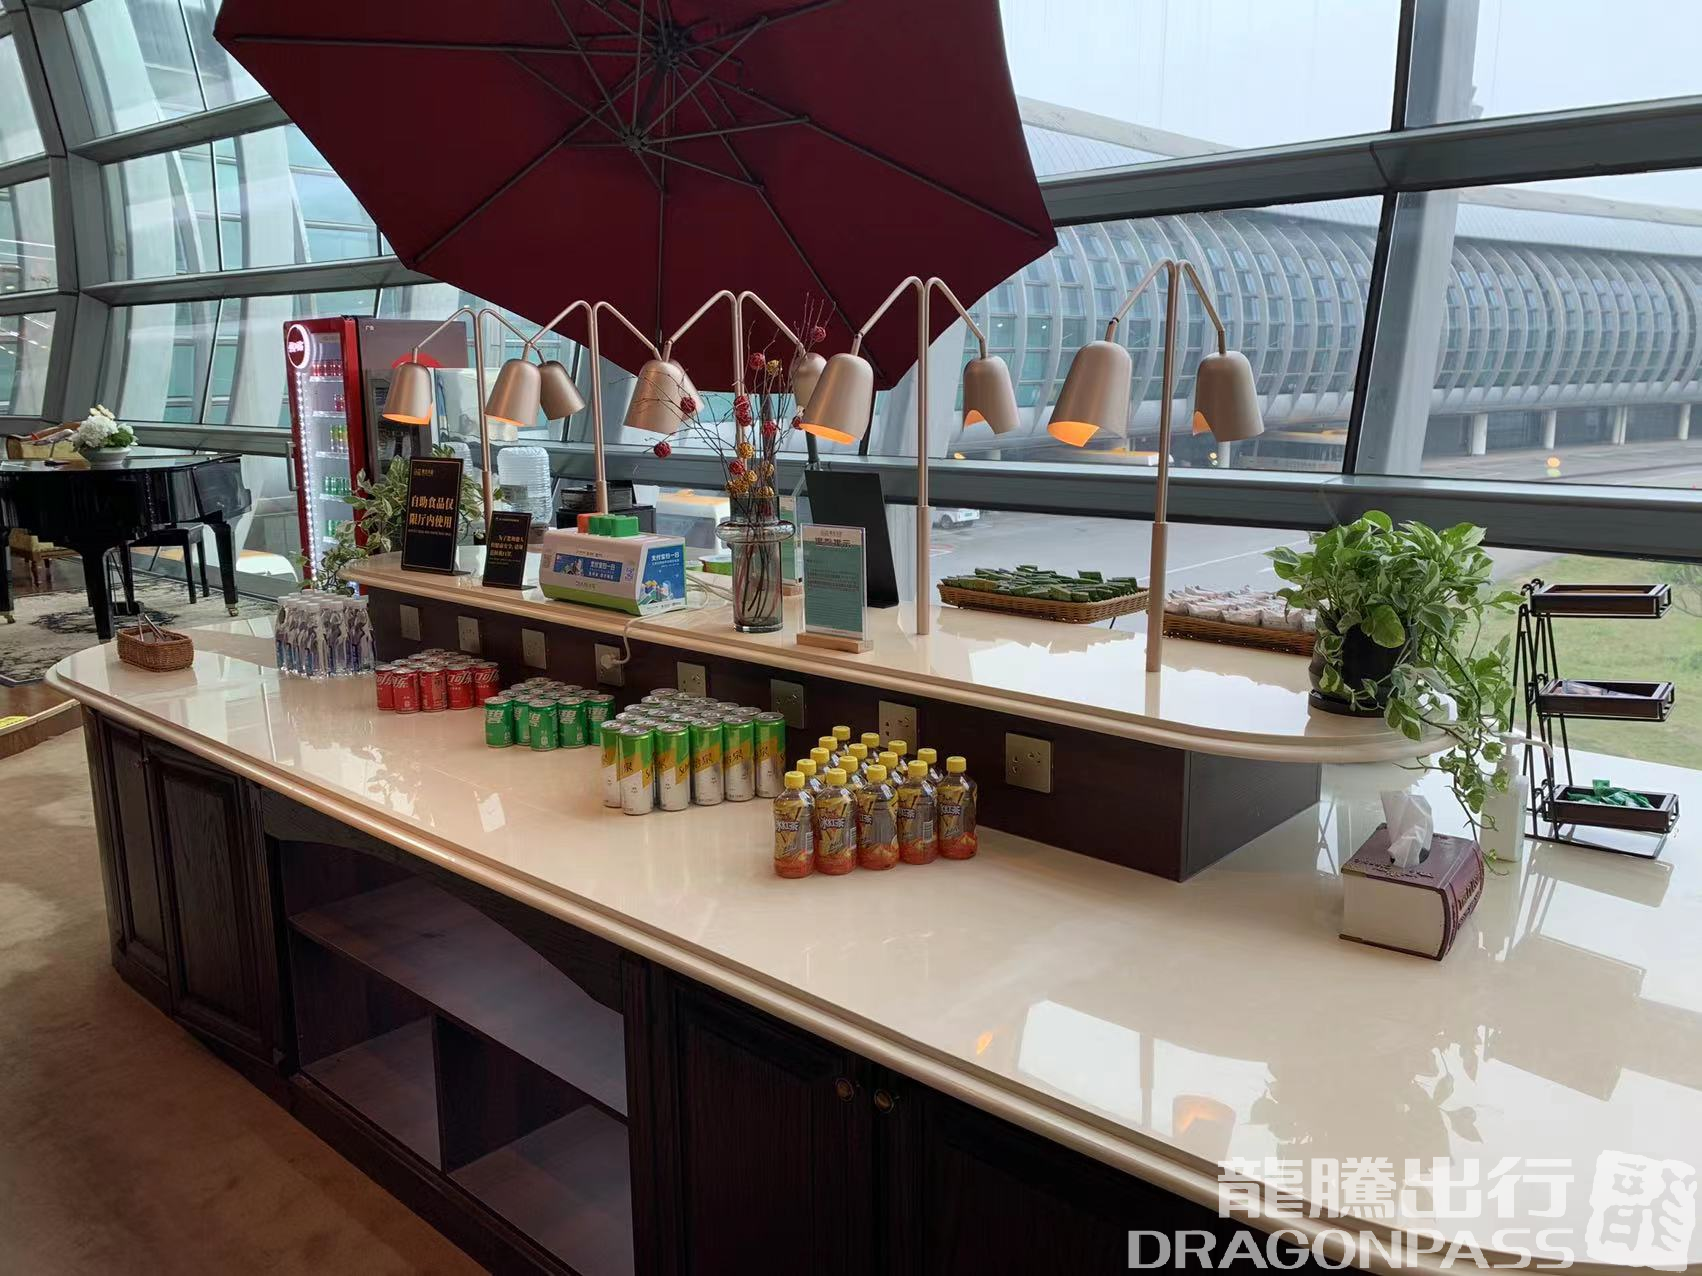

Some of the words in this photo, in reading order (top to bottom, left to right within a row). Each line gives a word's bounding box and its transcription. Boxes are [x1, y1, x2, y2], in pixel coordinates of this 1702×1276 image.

[411, 495, 455, 511] 自助食品仅
[408, 513, 453, 529] 限厅内使用
